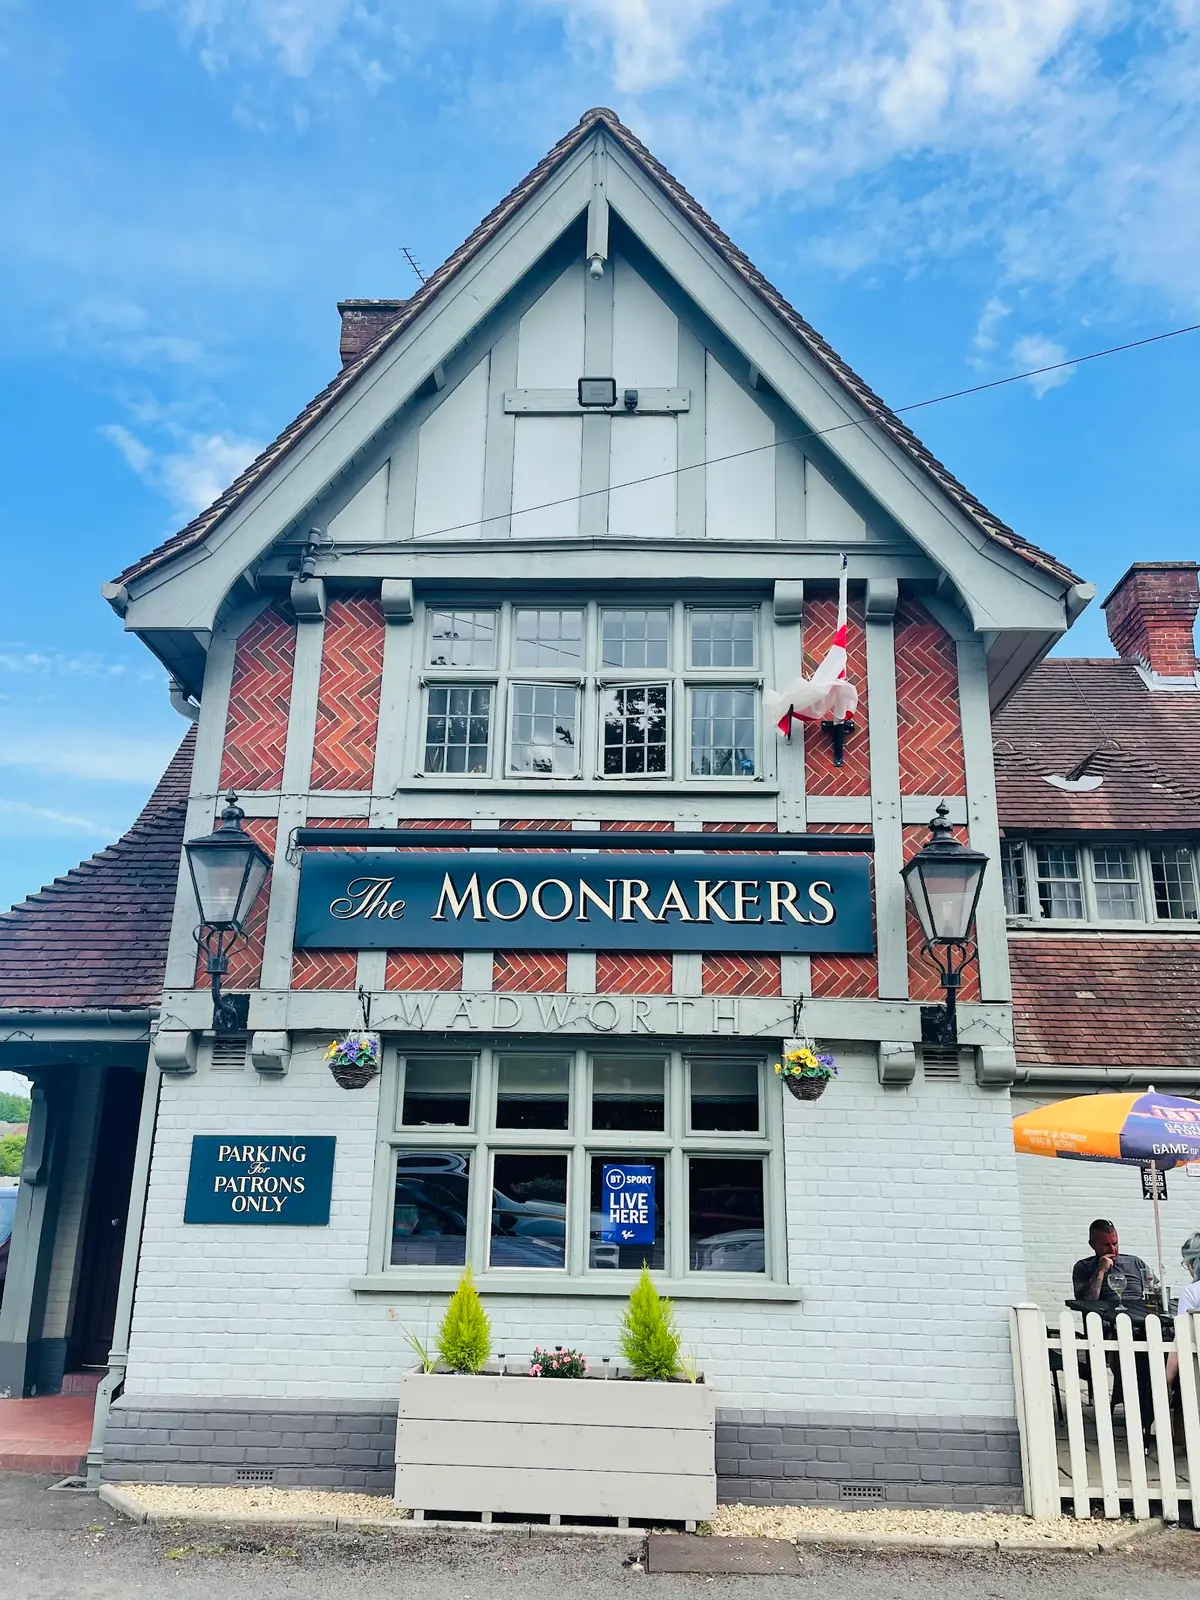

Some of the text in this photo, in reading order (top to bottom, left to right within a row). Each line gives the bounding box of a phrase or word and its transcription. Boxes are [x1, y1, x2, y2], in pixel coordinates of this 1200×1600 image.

[329, 871, 836, 925] The MOONRAKERS
[399, 993, 741, 1034] WADWORTH
[217, 1145, 307, 1163] PARKING
[1152, 1143, 1189, 1155] GAME
[247, 1161, 271, 1175] For
[213, 1176, 306, 1194] PATRONS
[610, 1175, 652, 1184] BT SPORT
[231, 1195, 288, 1212] ONLY
[609, 1192, 649, 1210] LIVE
[609, 1209, 649, 1224] HERE
